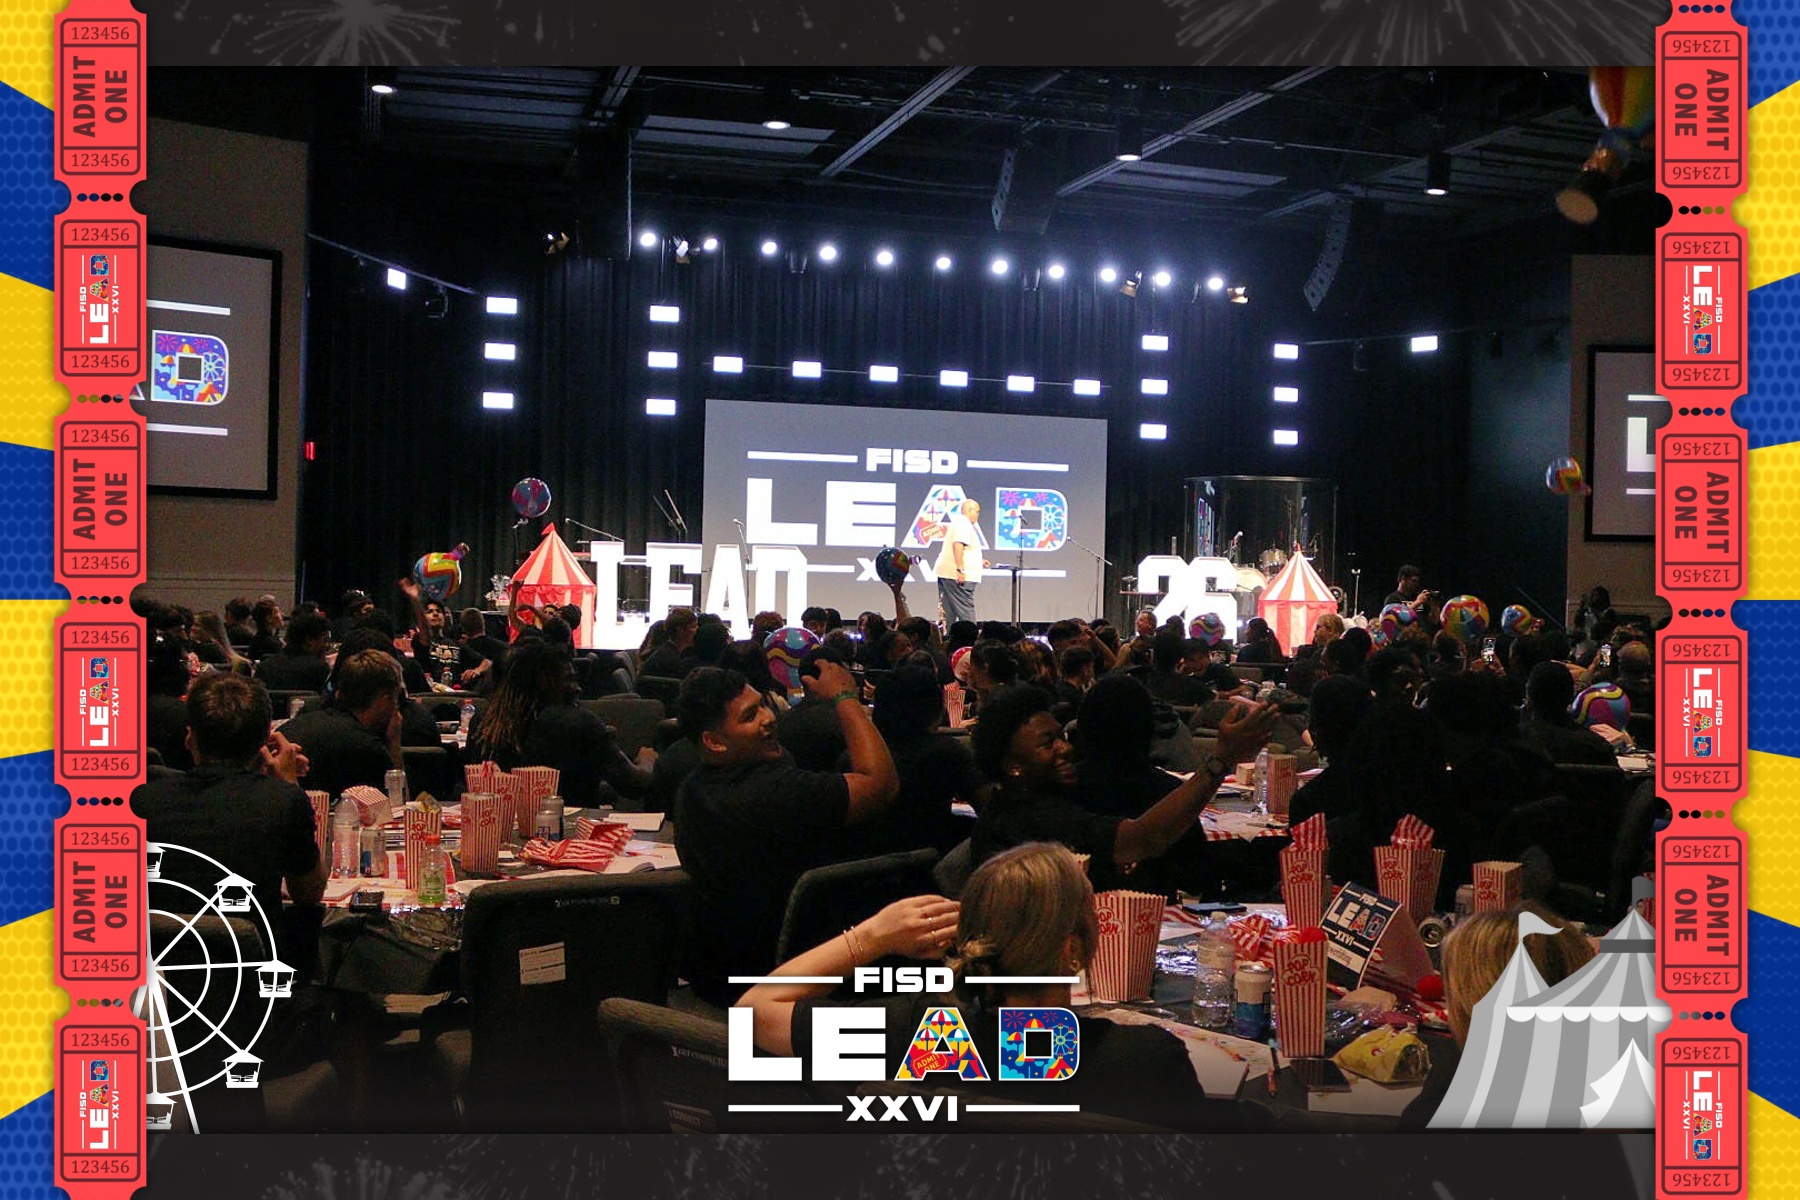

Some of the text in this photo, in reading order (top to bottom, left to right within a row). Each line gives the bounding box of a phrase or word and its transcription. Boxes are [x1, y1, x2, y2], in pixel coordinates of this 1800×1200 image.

[866, 447, 959, 475] FISD
[746, 477, 1068, 552] LEAD
[590, 540, 808, 649] LEAD
[1326, 897, 1387, 941] LEAD
[1284, 969, 1317, 987] CORN
[1287, 957, 1310, 974] POP
